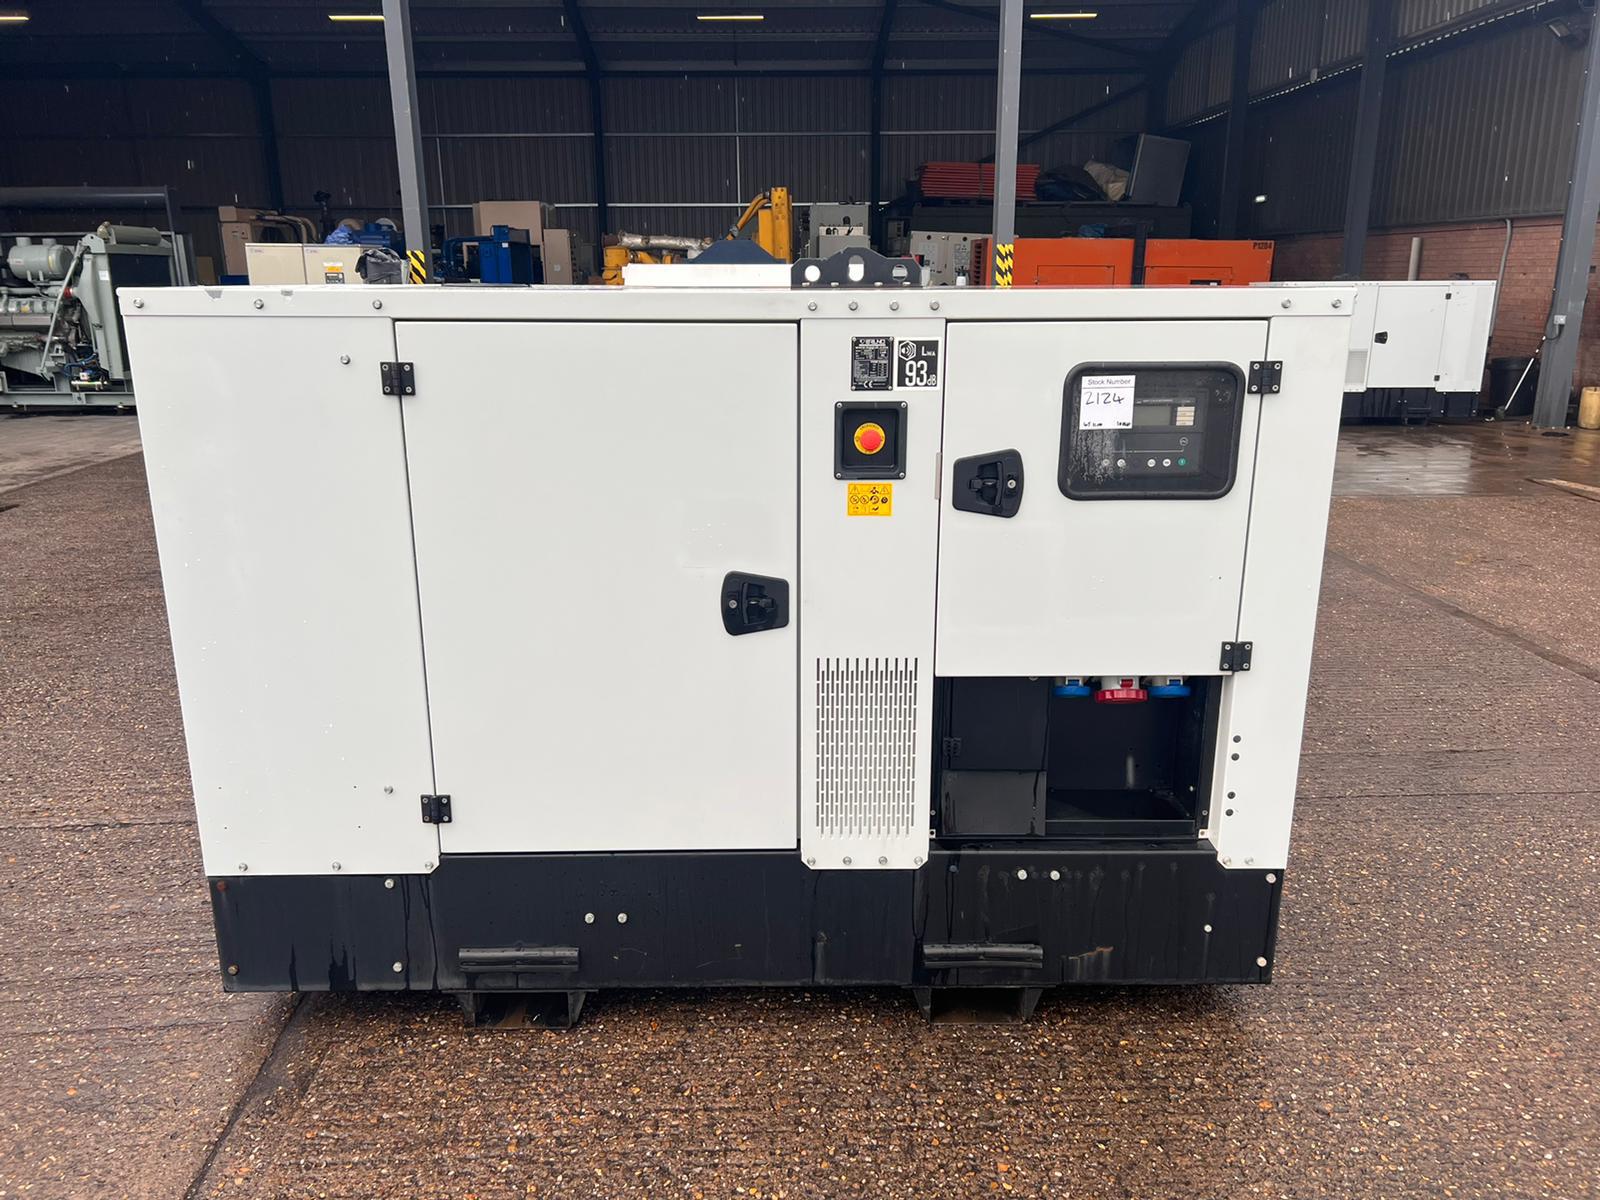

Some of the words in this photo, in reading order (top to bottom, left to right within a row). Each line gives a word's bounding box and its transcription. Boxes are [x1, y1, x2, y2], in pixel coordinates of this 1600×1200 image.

[905, 360, 928, 386] 93
[927, 374, 937, 386] dB
[1087, 378, 1105, 386] Stock
[1085, 391, 1125, 406] 2124
